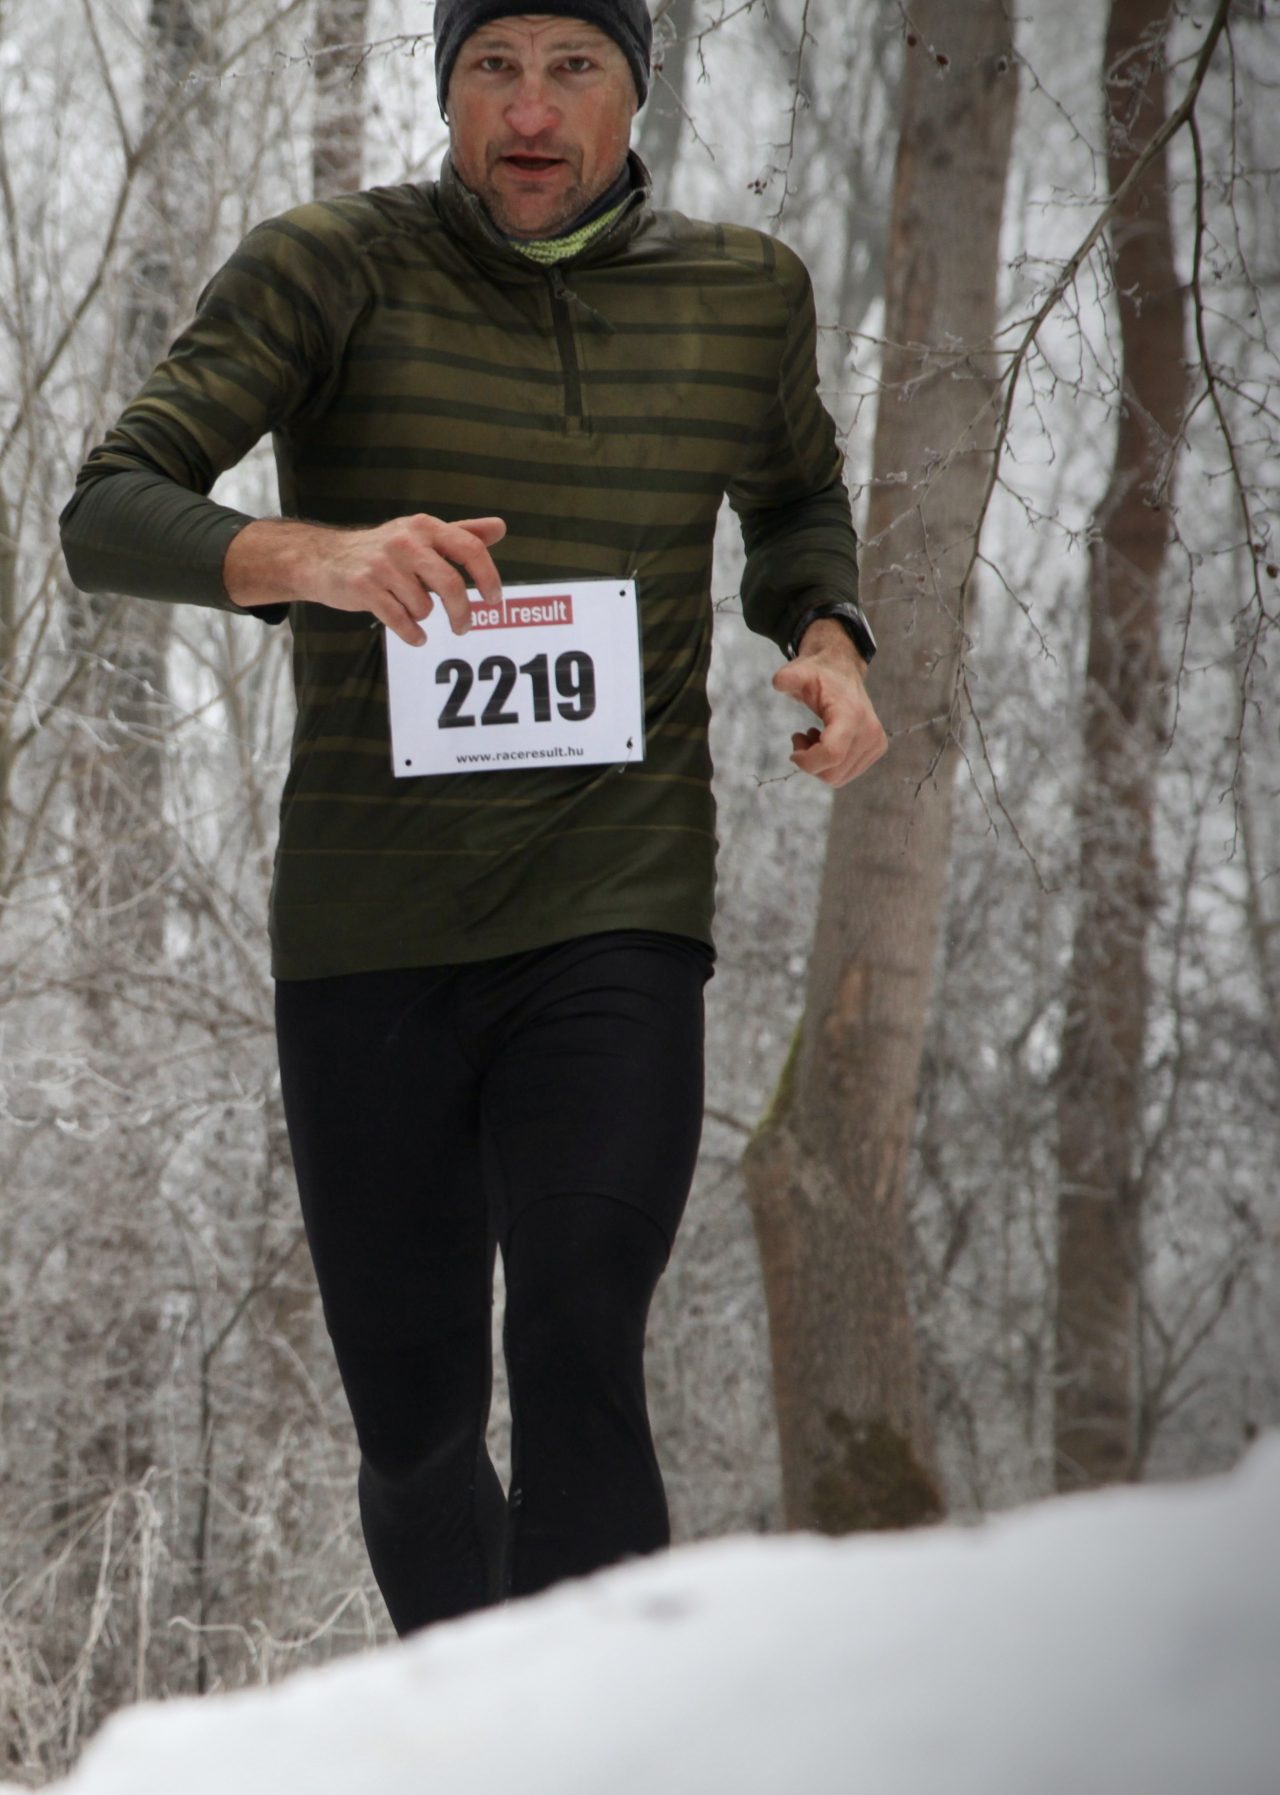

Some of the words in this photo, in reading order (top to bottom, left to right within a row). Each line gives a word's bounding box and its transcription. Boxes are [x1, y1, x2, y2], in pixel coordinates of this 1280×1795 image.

[470, 609, 499, 626] ace
[511, 600, 567, 623] result
[435, 650, 596, 729] 2219
[456, 746, 584, 763] www.raceresult.hu
